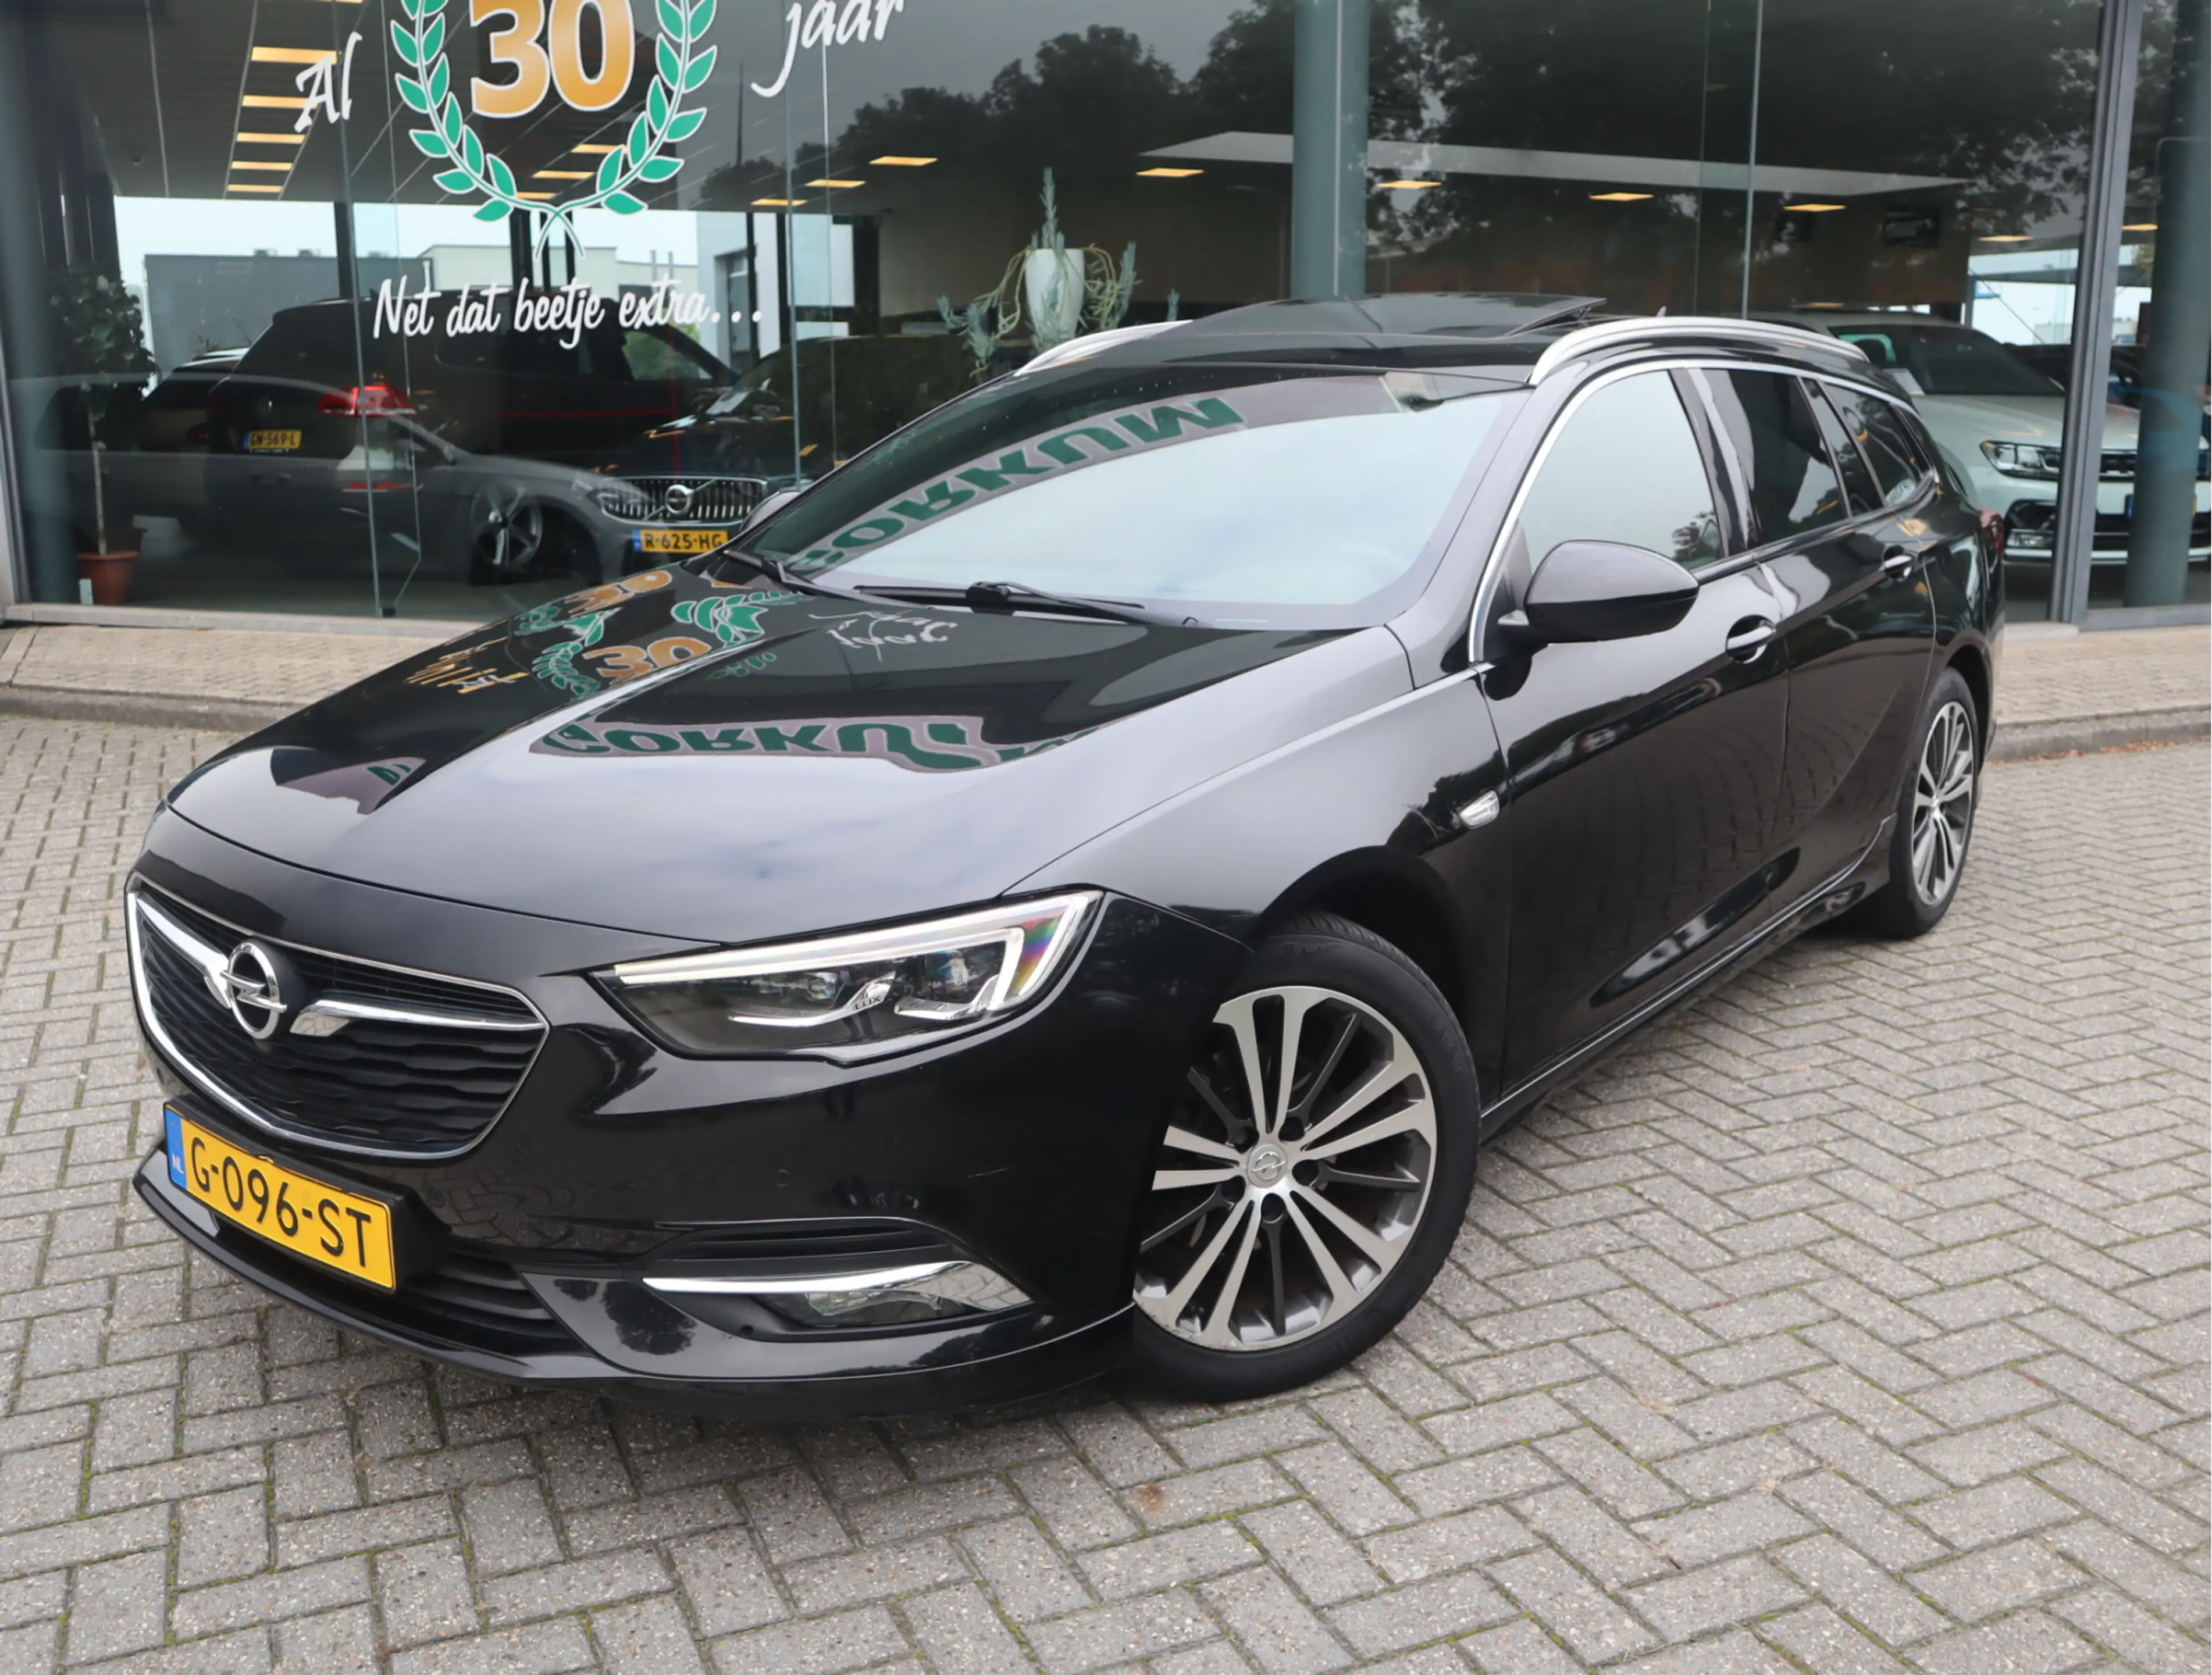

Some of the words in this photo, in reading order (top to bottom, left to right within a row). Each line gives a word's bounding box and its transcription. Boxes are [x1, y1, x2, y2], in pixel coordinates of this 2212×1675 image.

[294, 31, 363, 133] Al
[469, 0, 635, 118] 30
[751, 0, 904, 98] jaar
[373, 275, 442, 338] Net
[446, 283, 510, 337] dat
[514, 277, 605, 349] beetje
[619, 273, 762, 329] extra...
[644, 533, 722, 550] R-625-HG
[172, 1153, 184, 1175] NL
[191, 1136, 372, 1268] G-096-ST
